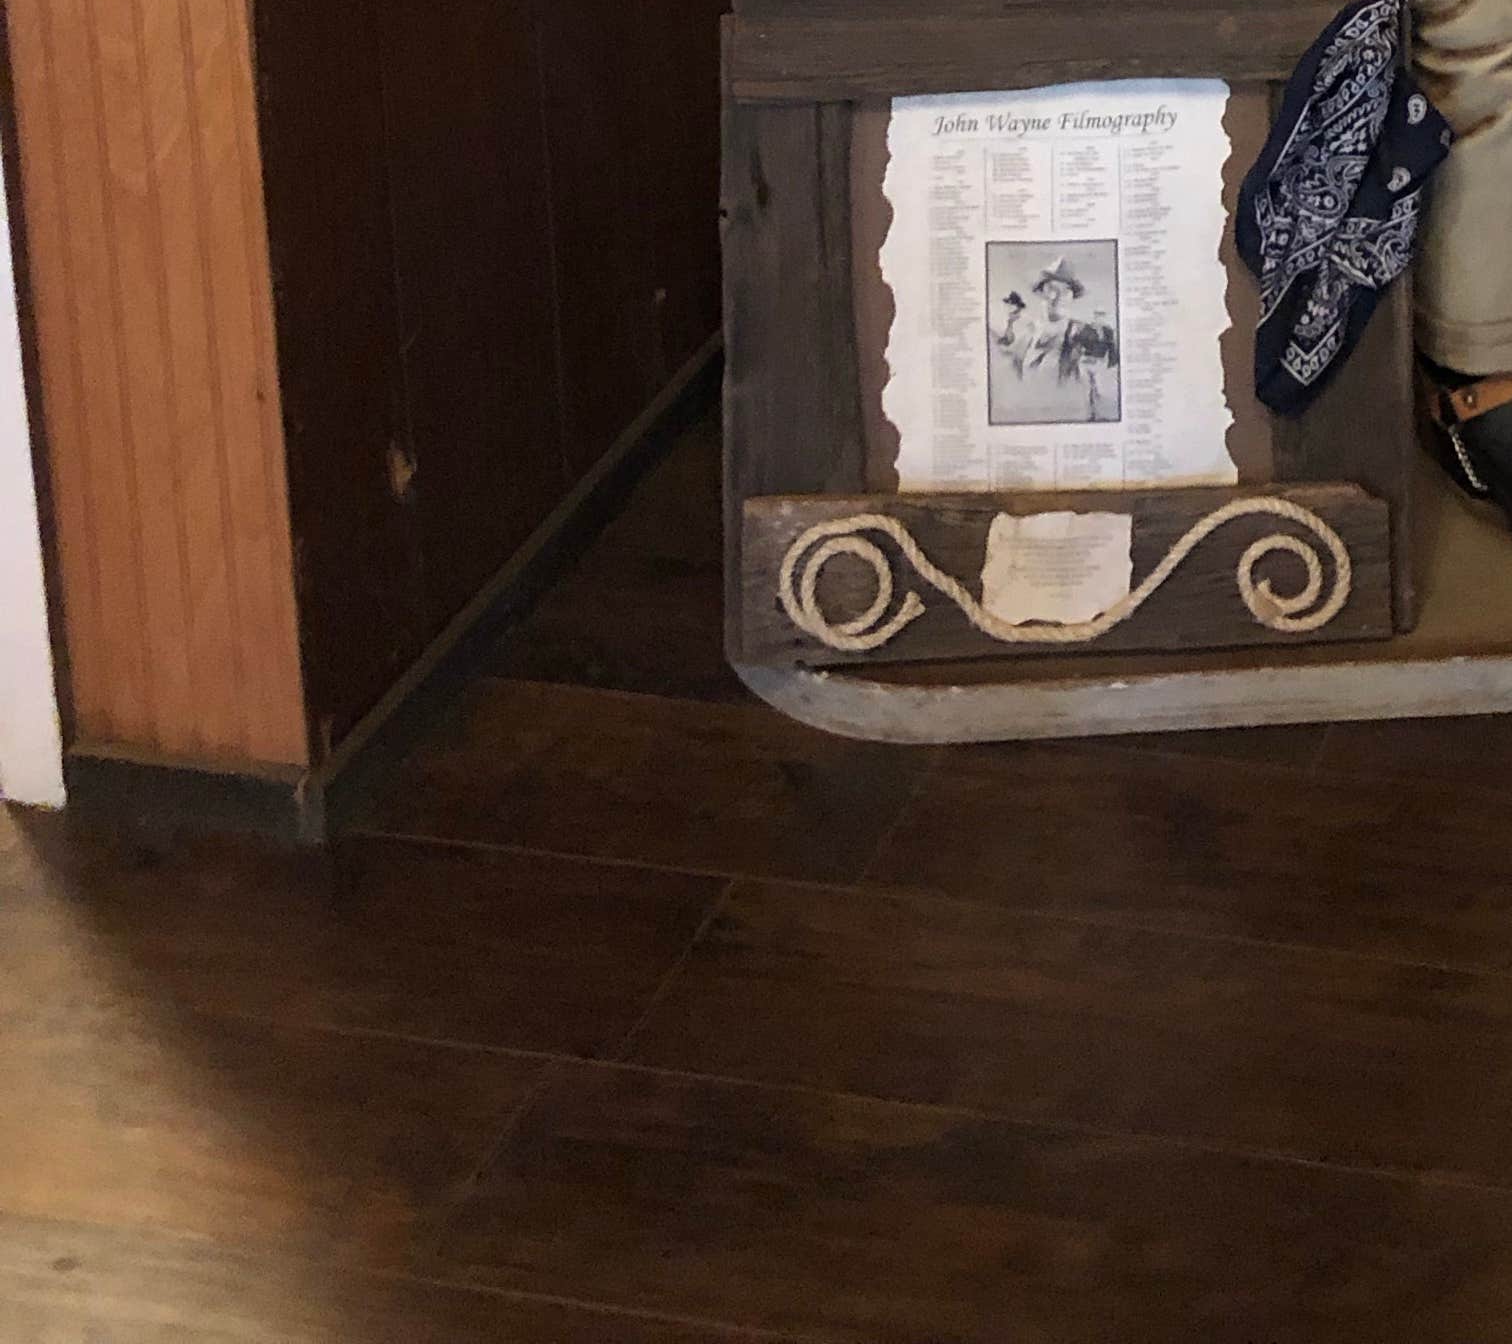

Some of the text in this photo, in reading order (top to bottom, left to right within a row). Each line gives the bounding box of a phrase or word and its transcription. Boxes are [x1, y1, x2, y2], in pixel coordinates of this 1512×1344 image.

[932, 104, 1178, 138] John Wayne Filmography
